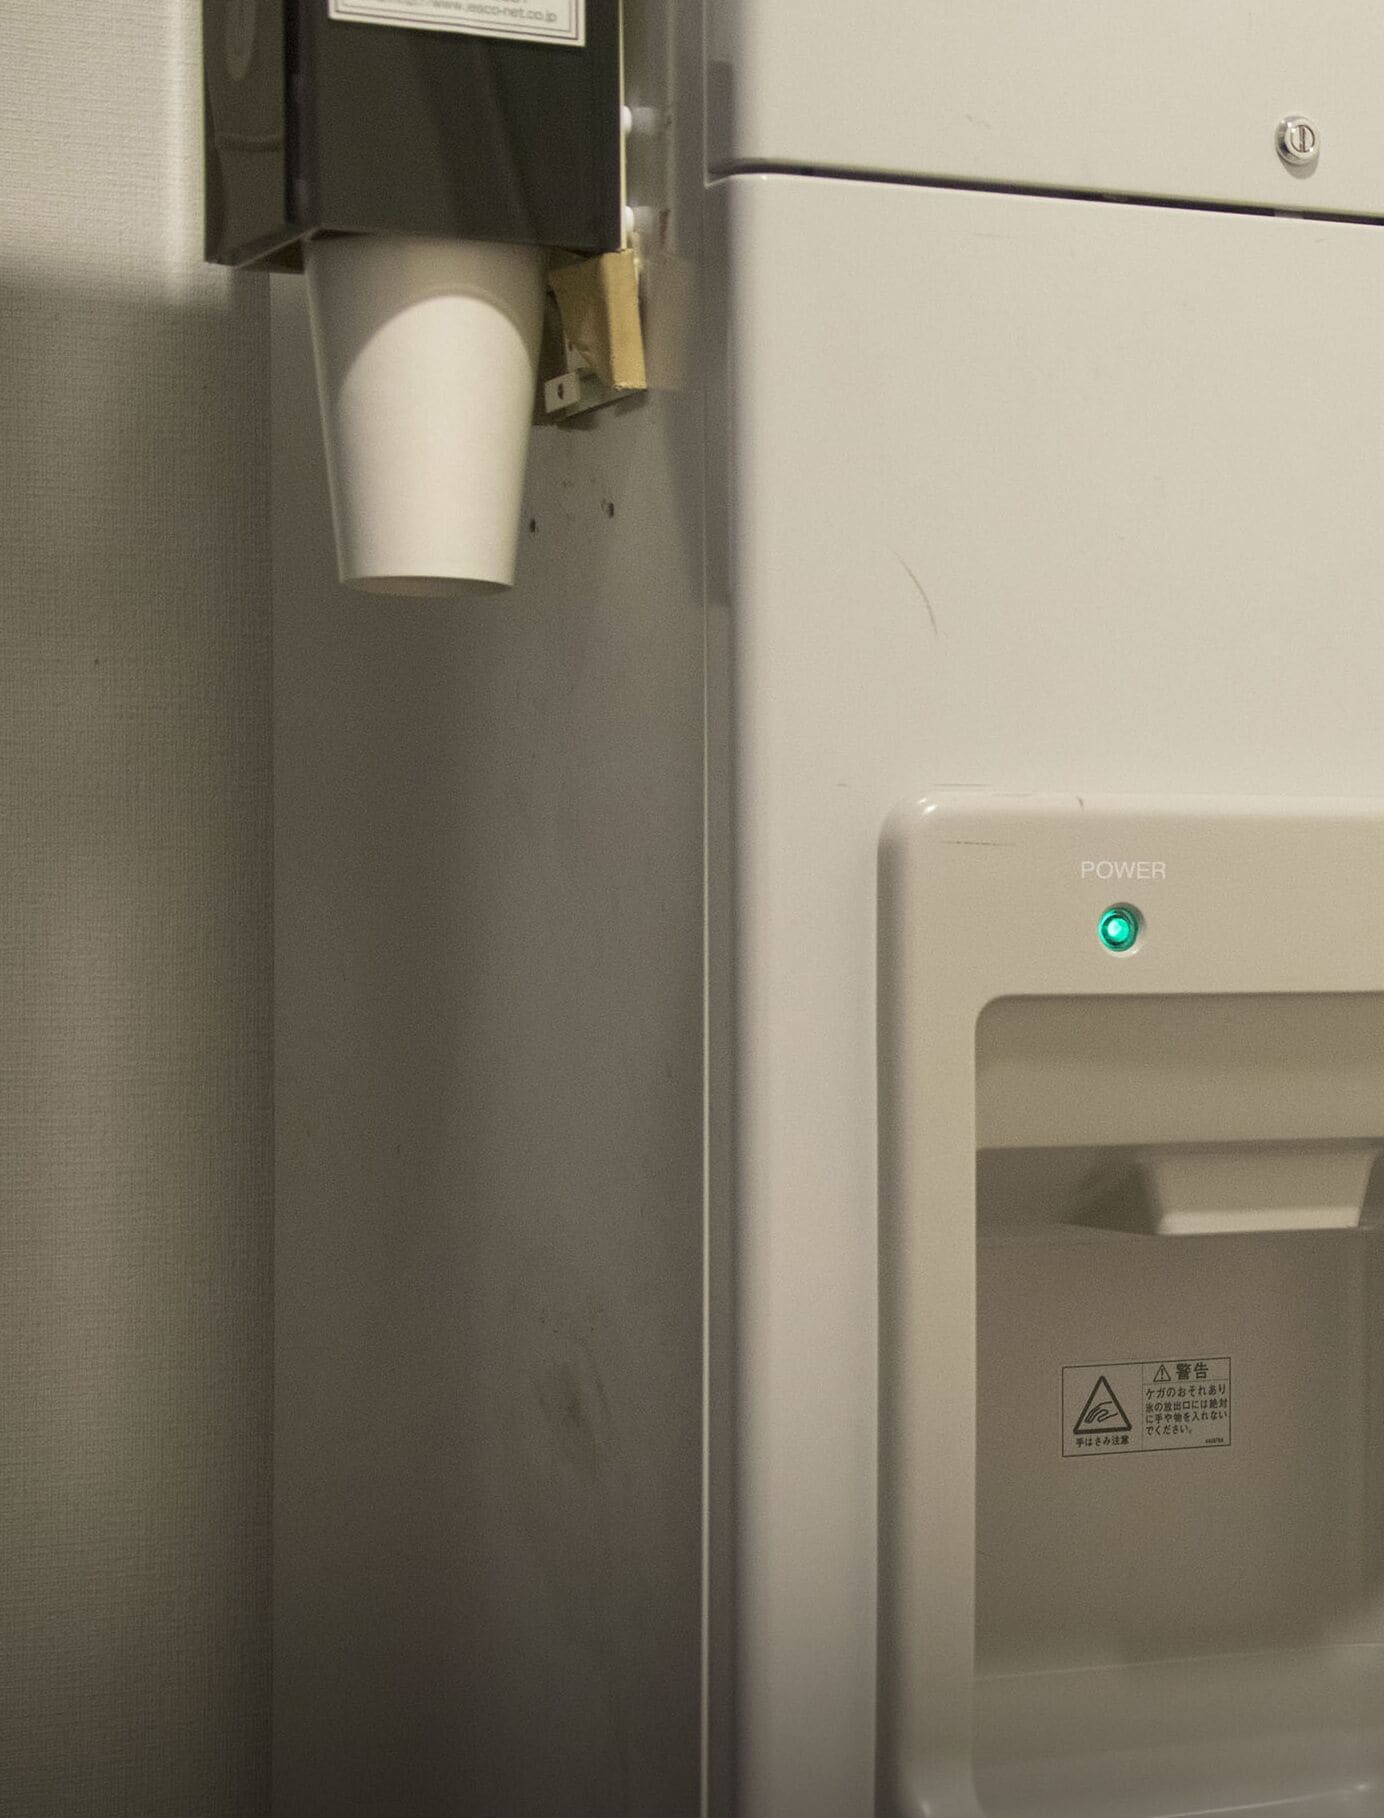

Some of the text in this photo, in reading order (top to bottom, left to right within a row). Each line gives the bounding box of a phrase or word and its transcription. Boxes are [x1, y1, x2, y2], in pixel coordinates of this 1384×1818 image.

[1080, 860, 1166, 880] POWER
[1176, 1362, 1208, 1380] 警告
[1145, 1383, 1226, 1399] ケガのおそれあり
[1145, 1411, 1228, 1424] に手や物を入れない
[1075, 1436, 1130, 1448] 手はさみ注意
